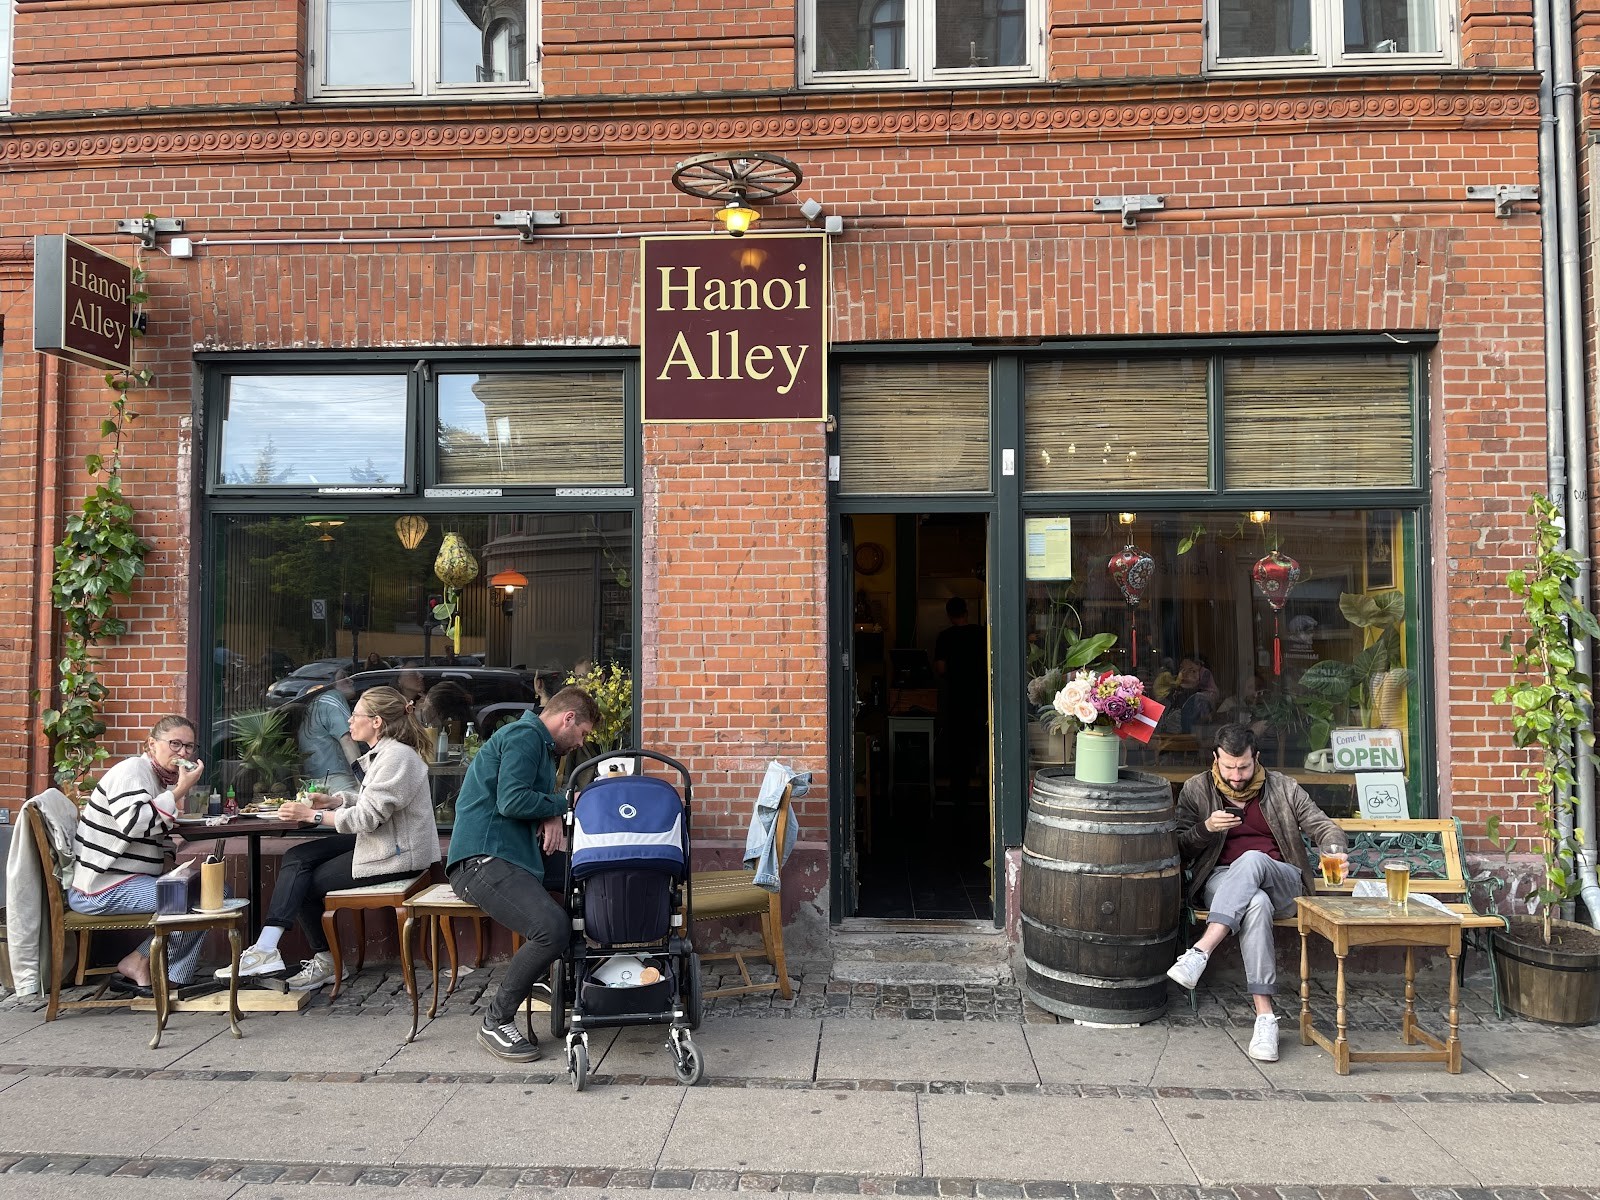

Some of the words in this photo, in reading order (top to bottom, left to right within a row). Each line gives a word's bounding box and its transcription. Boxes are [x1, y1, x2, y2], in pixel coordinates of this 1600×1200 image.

[70, 257, 127, 306] Hanoi
[656, 263, 811, 311] Hanoi
[70, 298, 126, 349] Alley
[656, 329, 809, 394] Alley
[1336, 735, 1357, 745] Come
[1358, 733, 1366, 741] in
[1337, 748, 1399, 767] OPEN
[1369, 738, 1393, 747] WE'RE
